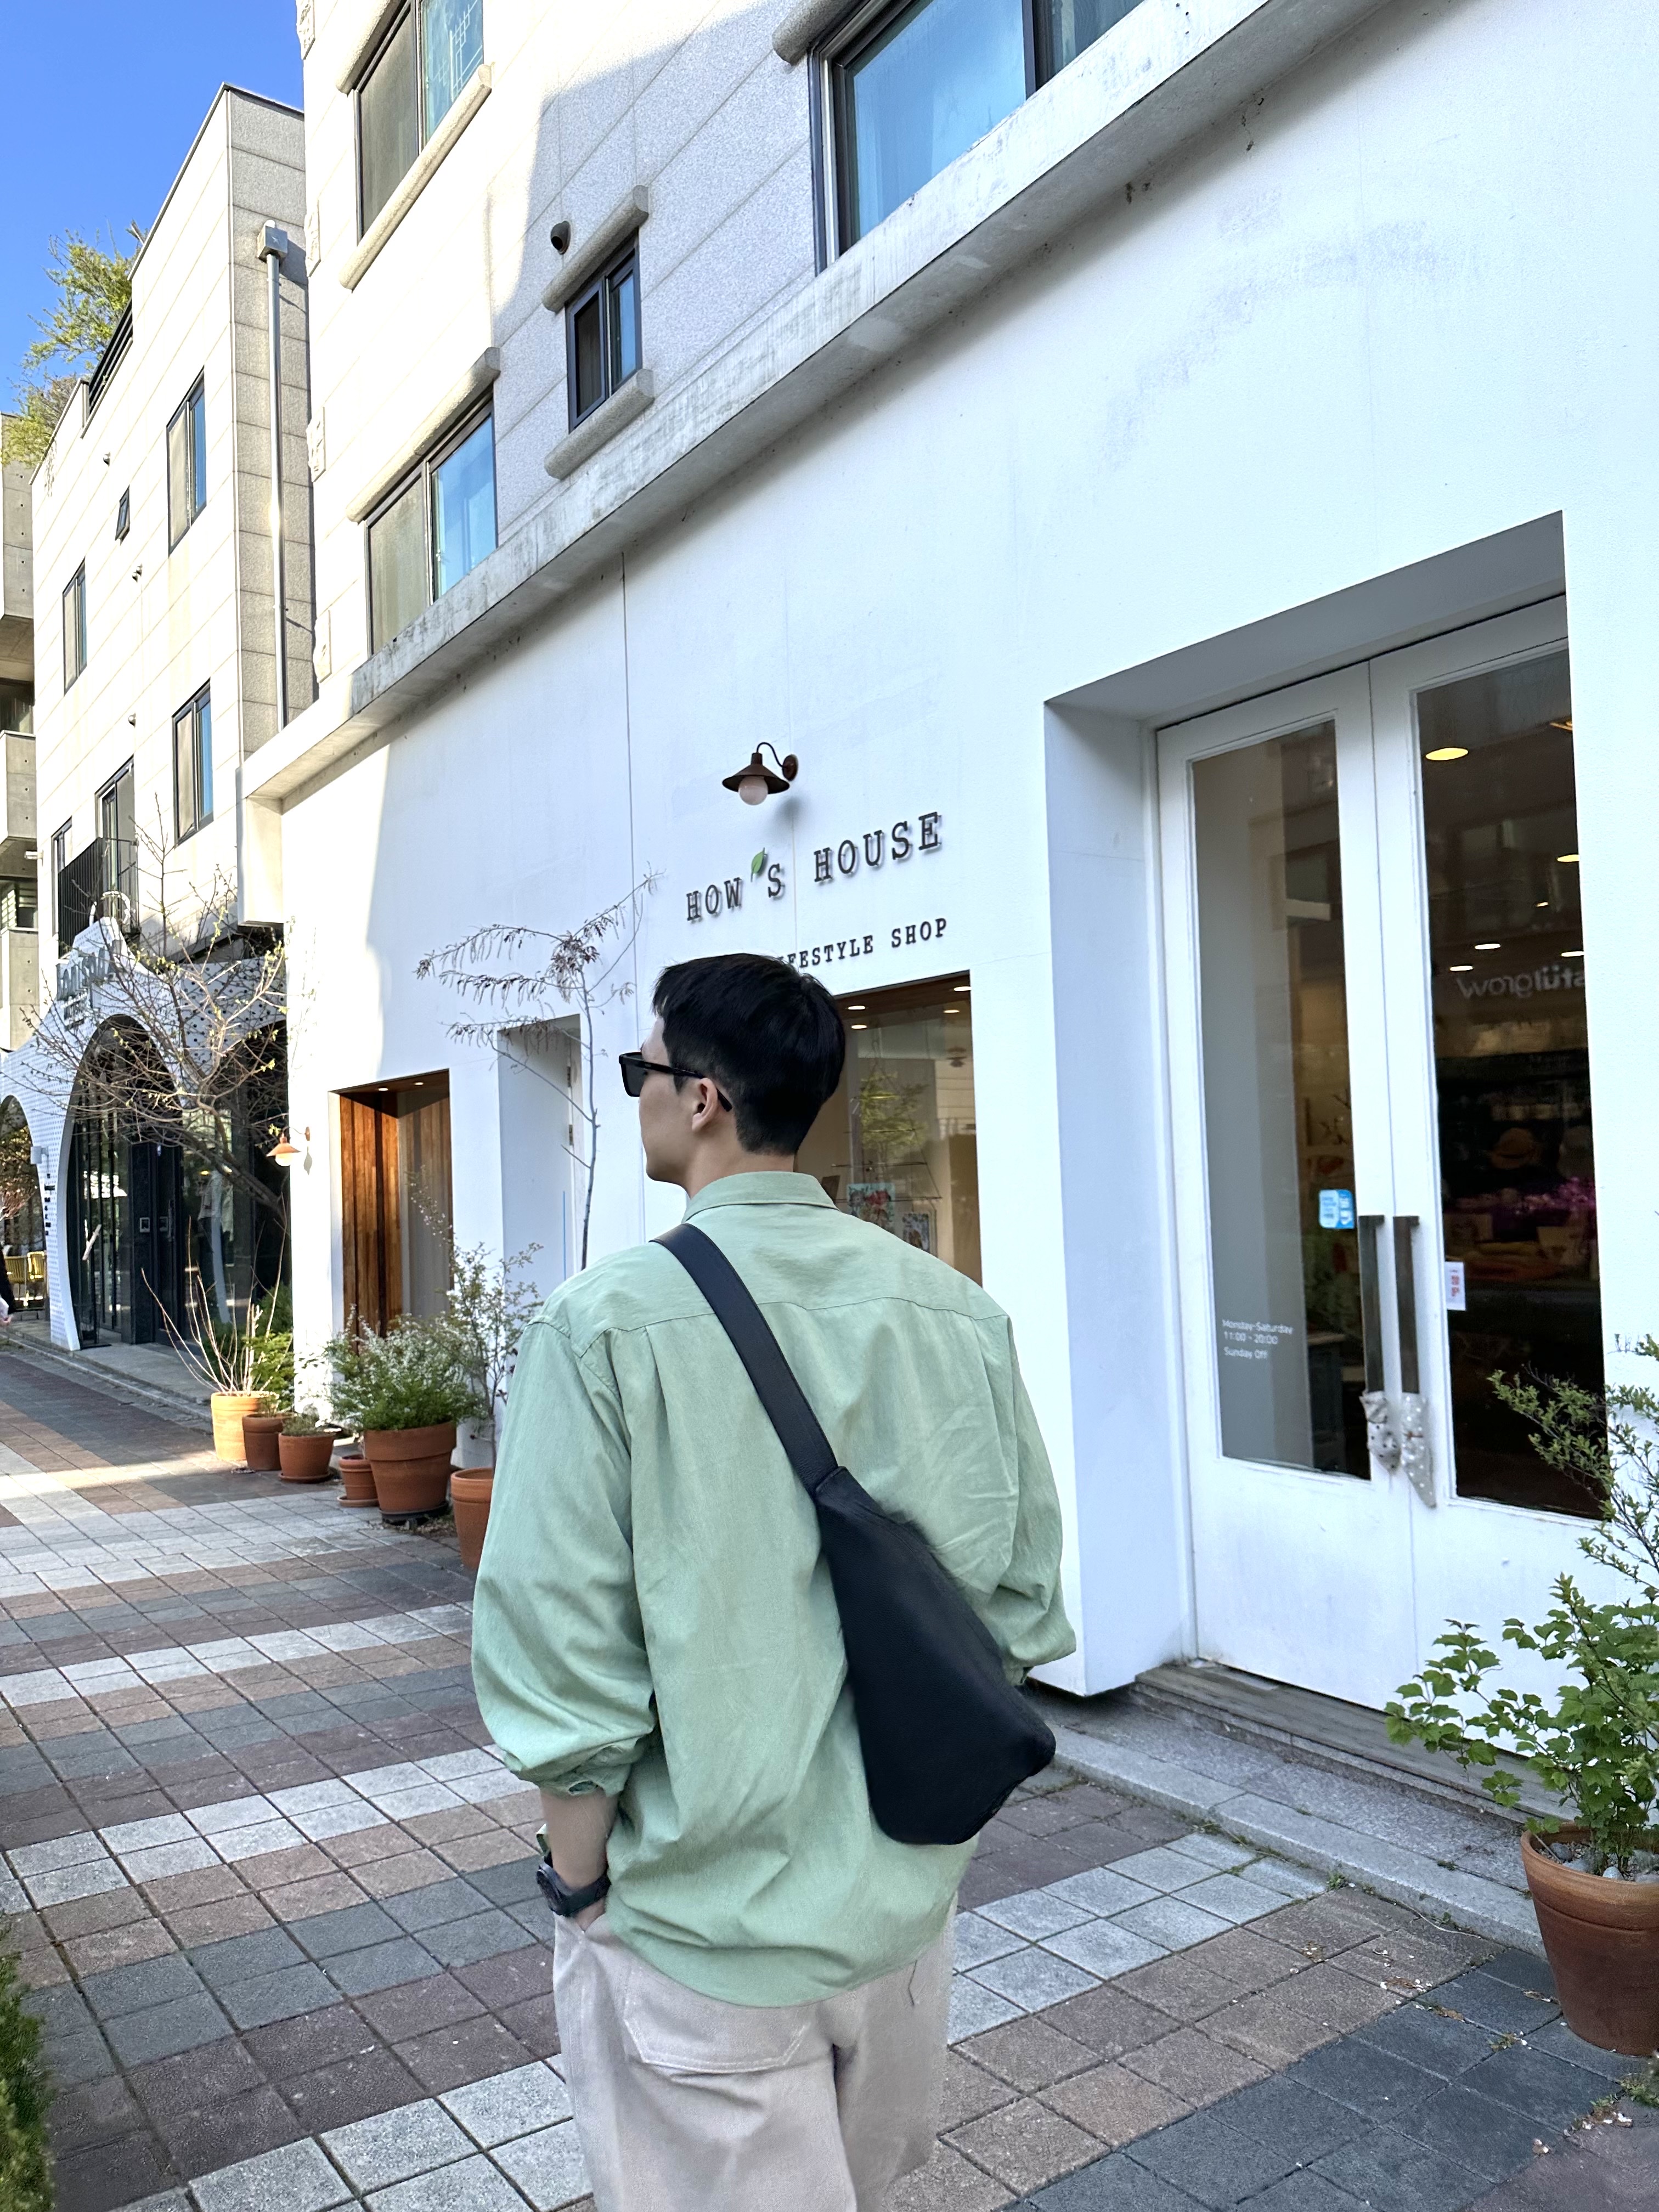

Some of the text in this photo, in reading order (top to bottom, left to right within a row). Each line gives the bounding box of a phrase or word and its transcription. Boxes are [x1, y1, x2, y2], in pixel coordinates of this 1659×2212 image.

[814, 811, 942, 883] HOUSE
[777, 917, 947, 968] FESTYLE SHOP
[1223, 1346, 1253, 1359] Sunday
